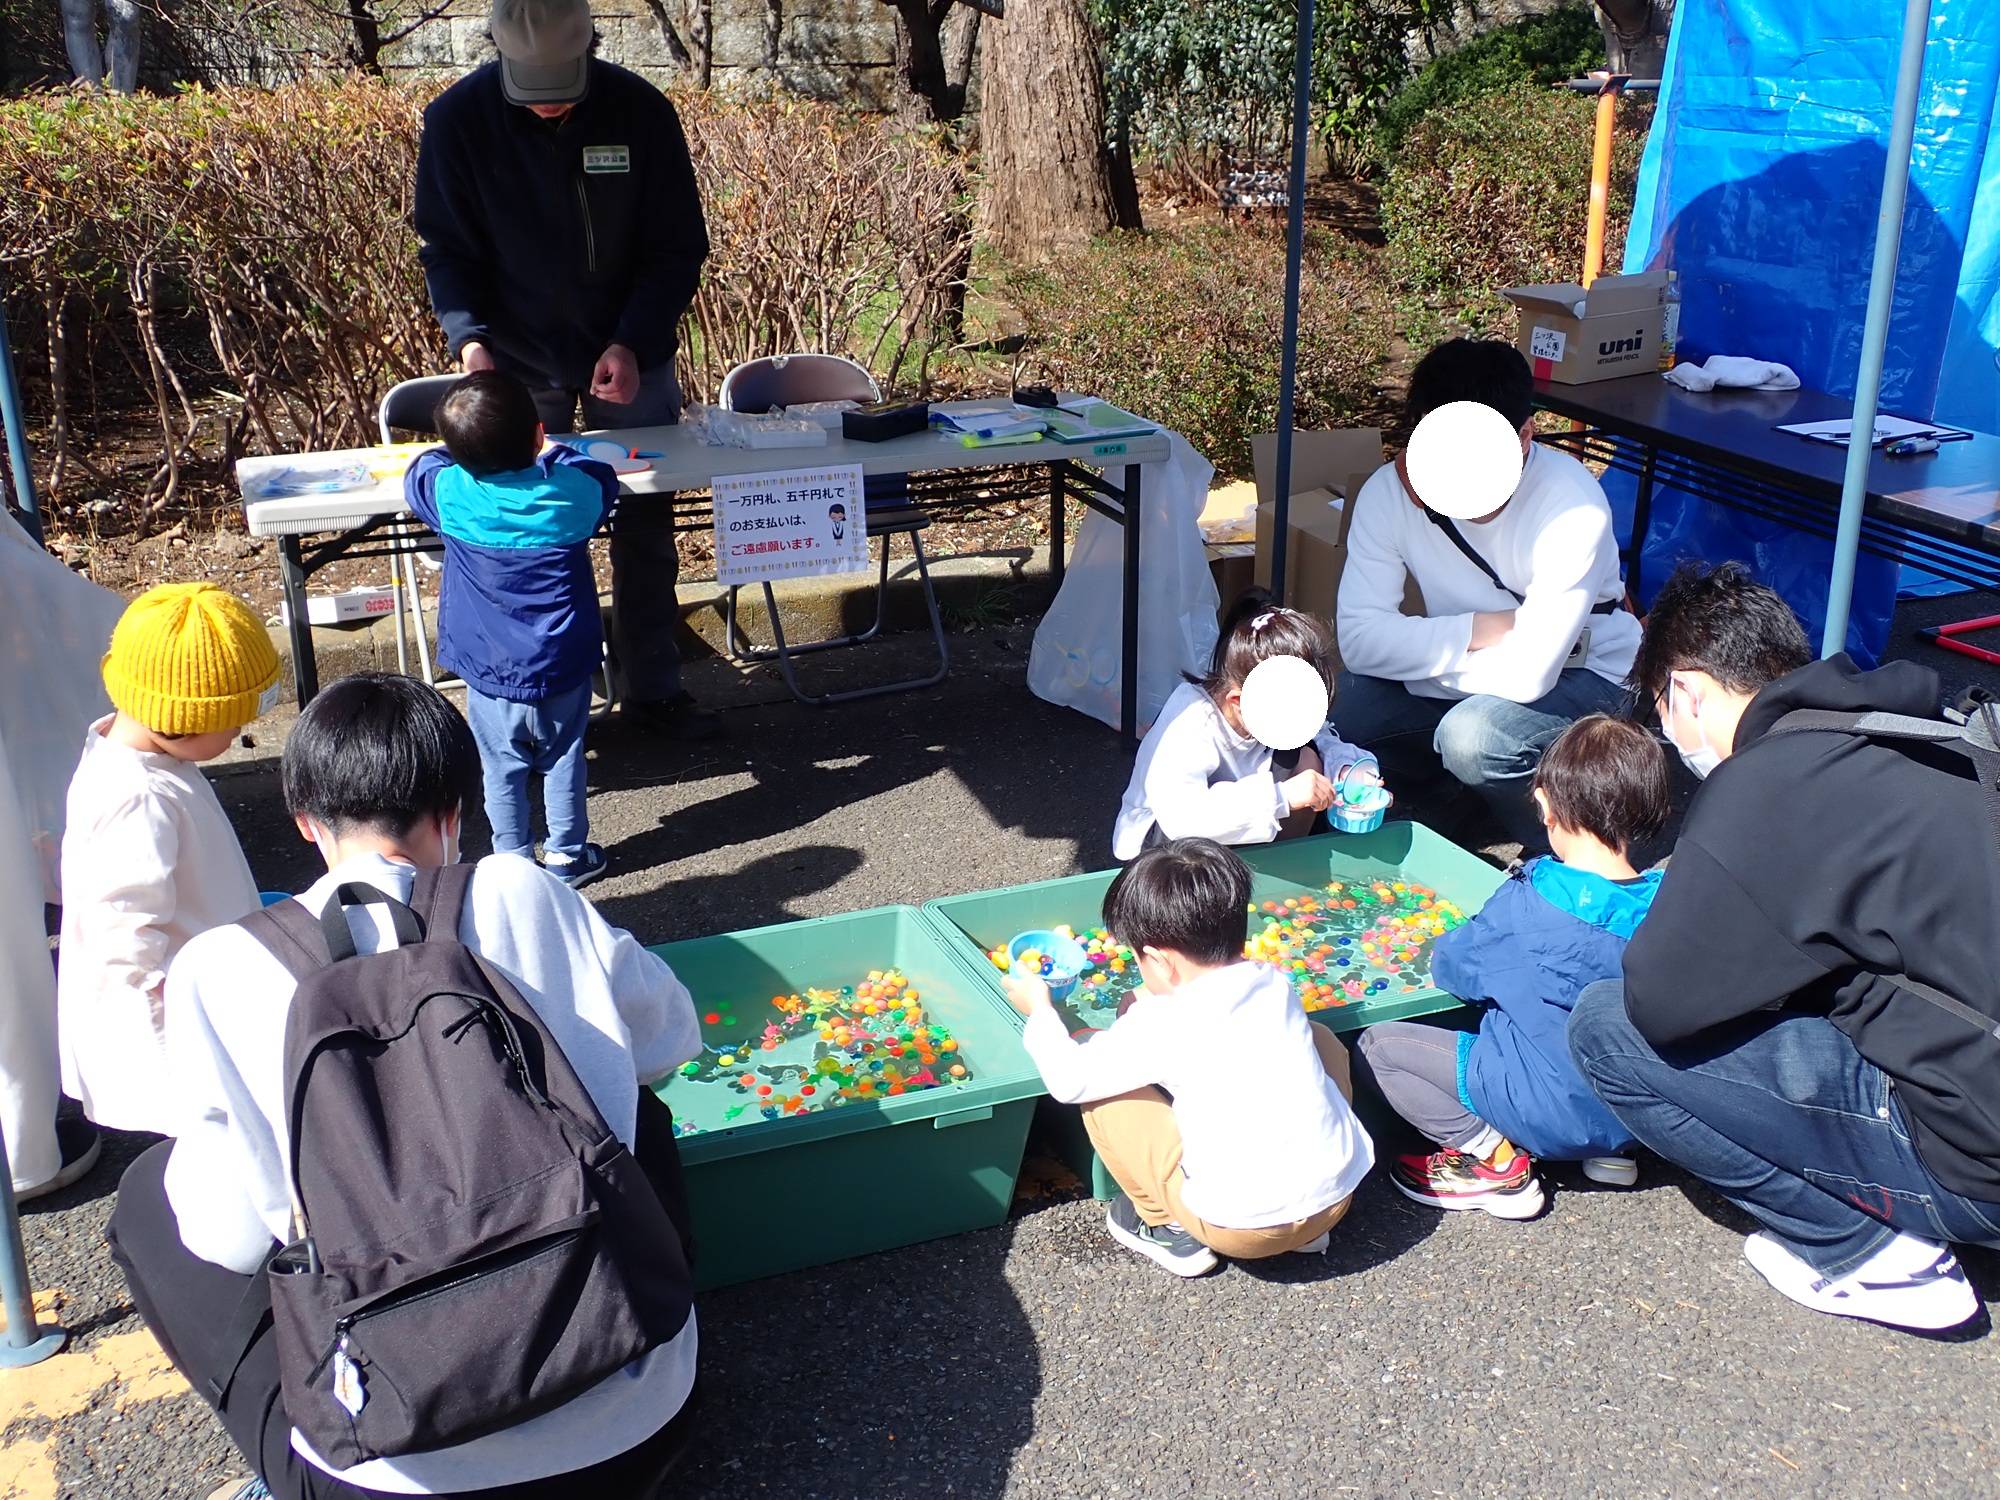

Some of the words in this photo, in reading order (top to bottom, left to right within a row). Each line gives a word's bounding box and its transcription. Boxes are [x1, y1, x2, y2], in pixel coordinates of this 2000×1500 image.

[1599, 329, 1643, 355] uni
[728, 487, 845, 507] 一万円札、五千円札で
[729, 514, 807, 532] のお支払いは、
[731, 537, 821, 556] ご遠慮願います。
